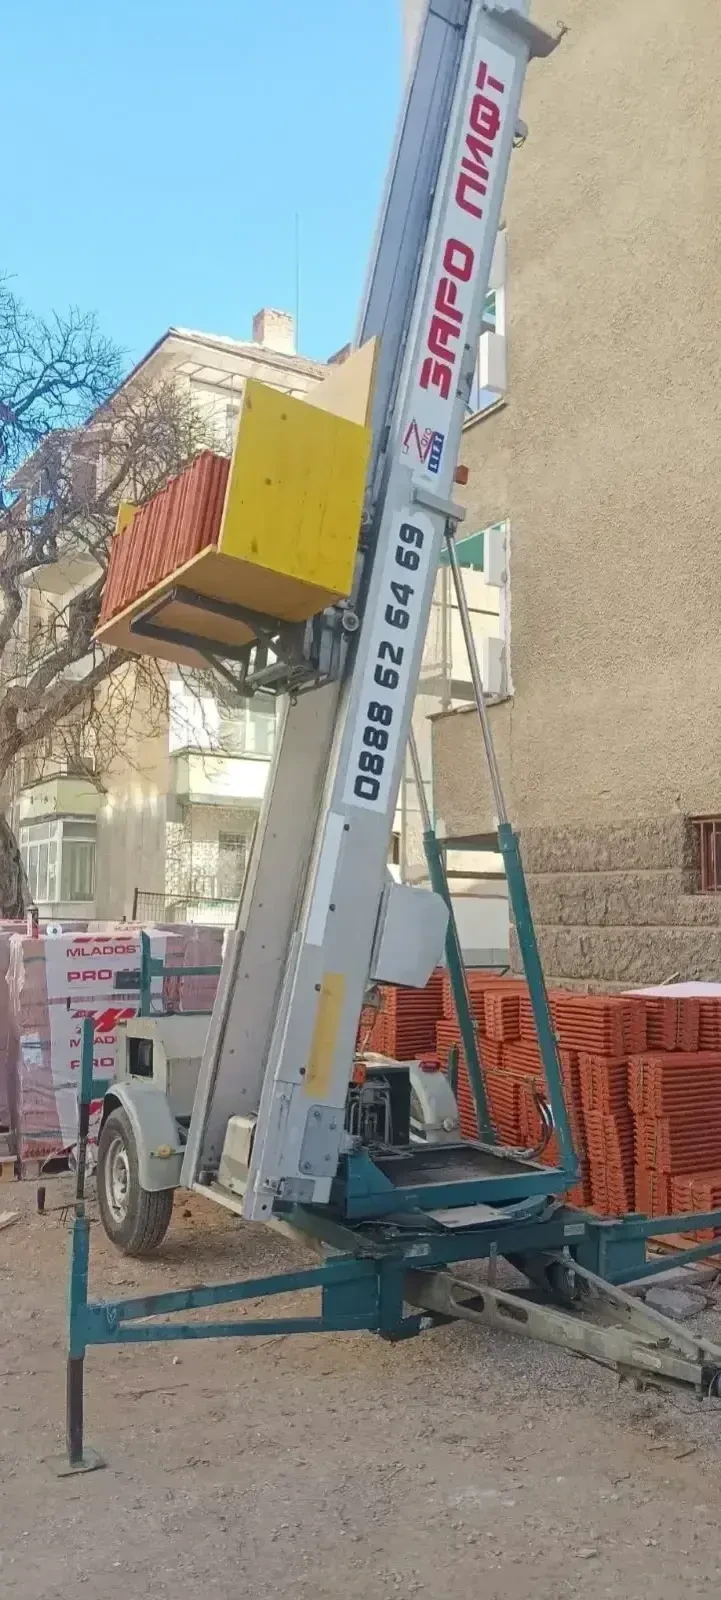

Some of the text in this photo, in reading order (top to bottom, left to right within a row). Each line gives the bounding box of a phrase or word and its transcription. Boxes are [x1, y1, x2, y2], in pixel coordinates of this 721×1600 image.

[419, 238, 475, 400] ЗАРО
[428, 433, 444, 471] LIFT
[353, 522, 425, 801] 0888 62 64 69
[67, 969, 113, 982] PRO
